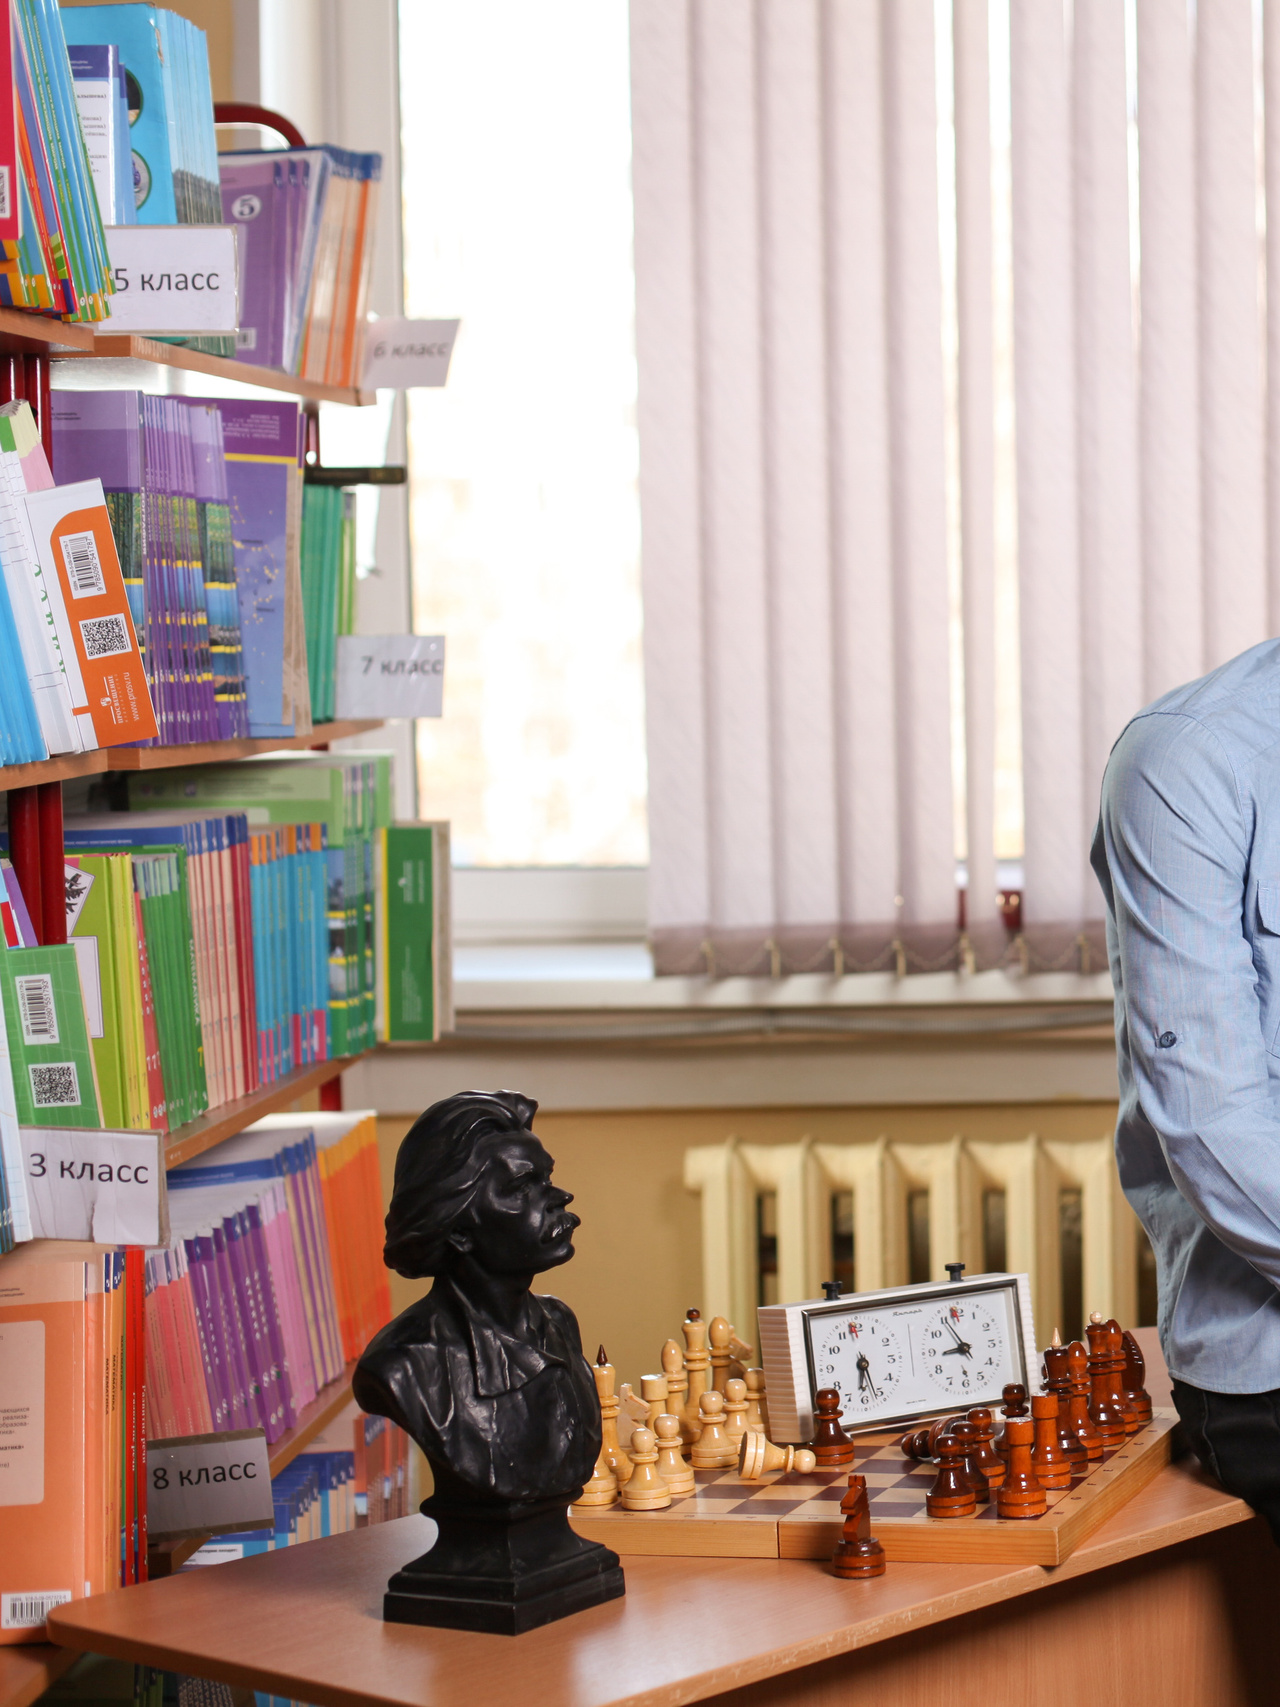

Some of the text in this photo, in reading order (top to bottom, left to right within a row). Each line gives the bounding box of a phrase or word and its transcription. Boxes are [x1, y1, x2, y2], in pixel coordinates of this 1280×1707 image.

[238, 198, 256, 218] 5
[114, 268, 220, 292] 5 класс
[373, 340, 449, 360] 6 класс
[361, 656, 443, 677] 7 класс
[108, 675, 124, 724] ПРОСВЕЩЕНИЕ
[124, 672, 140, 721] www.prosv.ru
[30, 1153, 47, 1178] 3
[60, 1159, 149, 1185] класс
[838, 1332, 847, 1341] 11
[931, 1330, 942, 1339] 10
[987, 1339, 996, 1348] 3
[829, 1345, 840, 1355] 10
[928, 1348, 936, 1357] 9
[887, 1355, 896, 1364] 3
[984, 1357, 994, 1366] 4
[826, 1365, 835, 1374] 9
[935, 1365, 943, 1374] 8
[884, 1373, 894, 1382] 4
[977, 1371, 985, 1381] 5
[833, 1381, 842, 1391] 8
[946, 1377, 954, 1386] 7
[962, 1379, 970, 1388] 6
[845, 1393, 852, 1403] 7
[861, 1395, 869, 1405] 6
[153, 1461, 257, 1490] 8 класс
